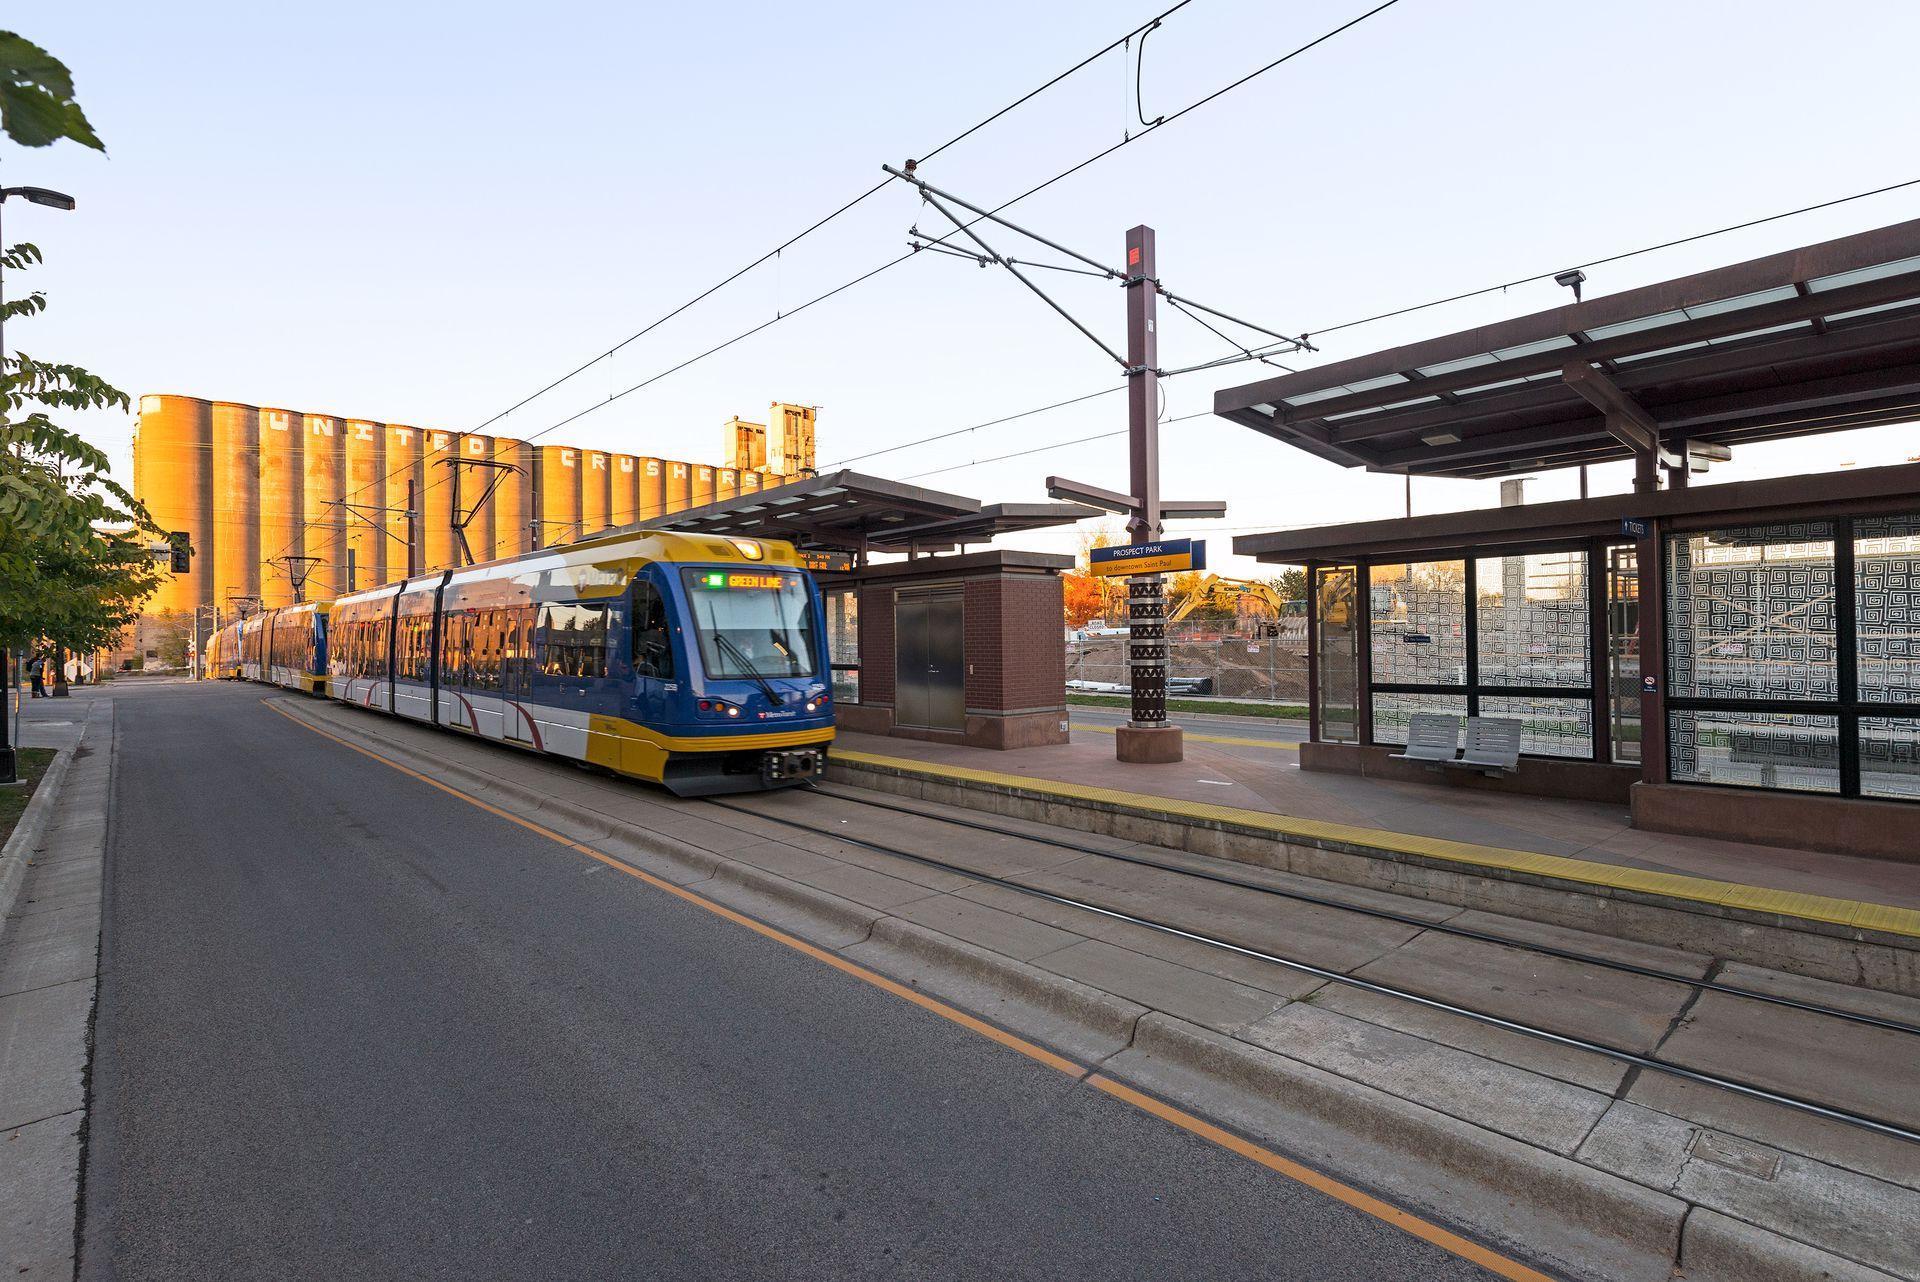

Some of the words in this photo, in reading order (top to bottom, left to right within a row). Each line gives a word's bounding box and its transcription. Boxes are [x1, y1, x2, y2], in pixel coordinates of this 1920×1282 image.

[269, 412, 485, 455] UNITED
[561, 449, 758, 487] CRUSHERS
[1113, 547, 1143, 557] PROSPECT
[1145, 545, 1163, 554] PARK
[1113, 562, 1143, 571] downtown
[1144, 561, 1158, 569] Saint
[1159, 559, 1172, 568] Paul
[728, 575, 759, 587] GREEN
[760, 576, 783, 588] LINE
